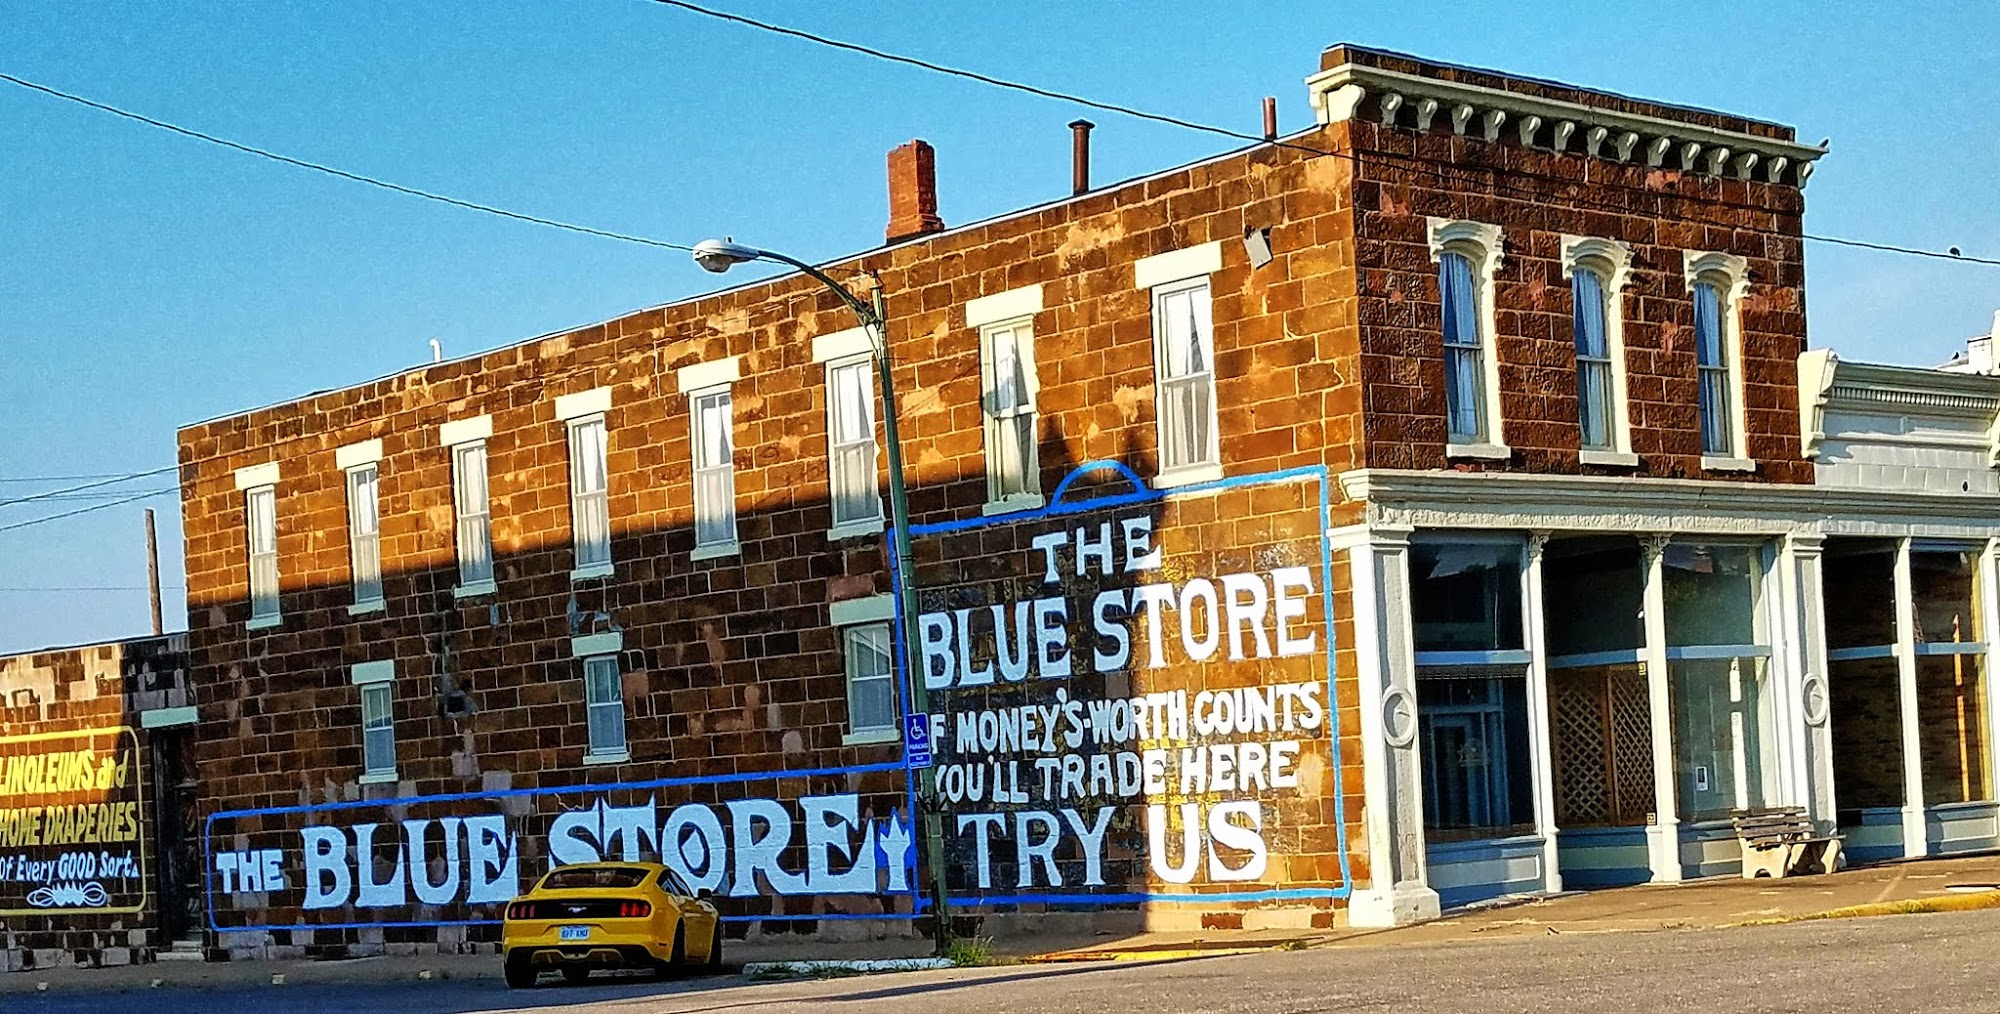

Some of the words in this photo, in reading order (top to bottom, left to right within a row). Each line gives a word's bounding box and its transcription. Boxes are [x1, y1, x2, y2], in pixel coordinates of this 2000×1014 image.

[1033, 515, 1161, 583] THE
[918, 596, 1072, 690] BLUE
[1093, 566, 1316, 673] STORE
[930, 713, 946, 755] F
[1193, 682, 1323, 736] COUNTS
[0, 749, 96, 796] LINOLEUMS
[96, 750, 129, 790] and
[934, 754, 1029, 804] YOU'LL
[1035, 752, 1166, 801] TRADE
[1181, 741, 1300, 795] HERE
[0, 807, 42, 848] HOME
[43, 801, 138, 846] DRAPERIES
[215, 848, 285, 894] THE
[301, 815, 518, 909] BLUE
[548, 791, 877, 897] STORE
[957, 805, 1117, 890] TRY
[1148, 801, 1268, 884] US
[0, 855, 15, 881] Of
[16, 854, 56, 885] Every
[58, 851, 97, 881] GOOD
